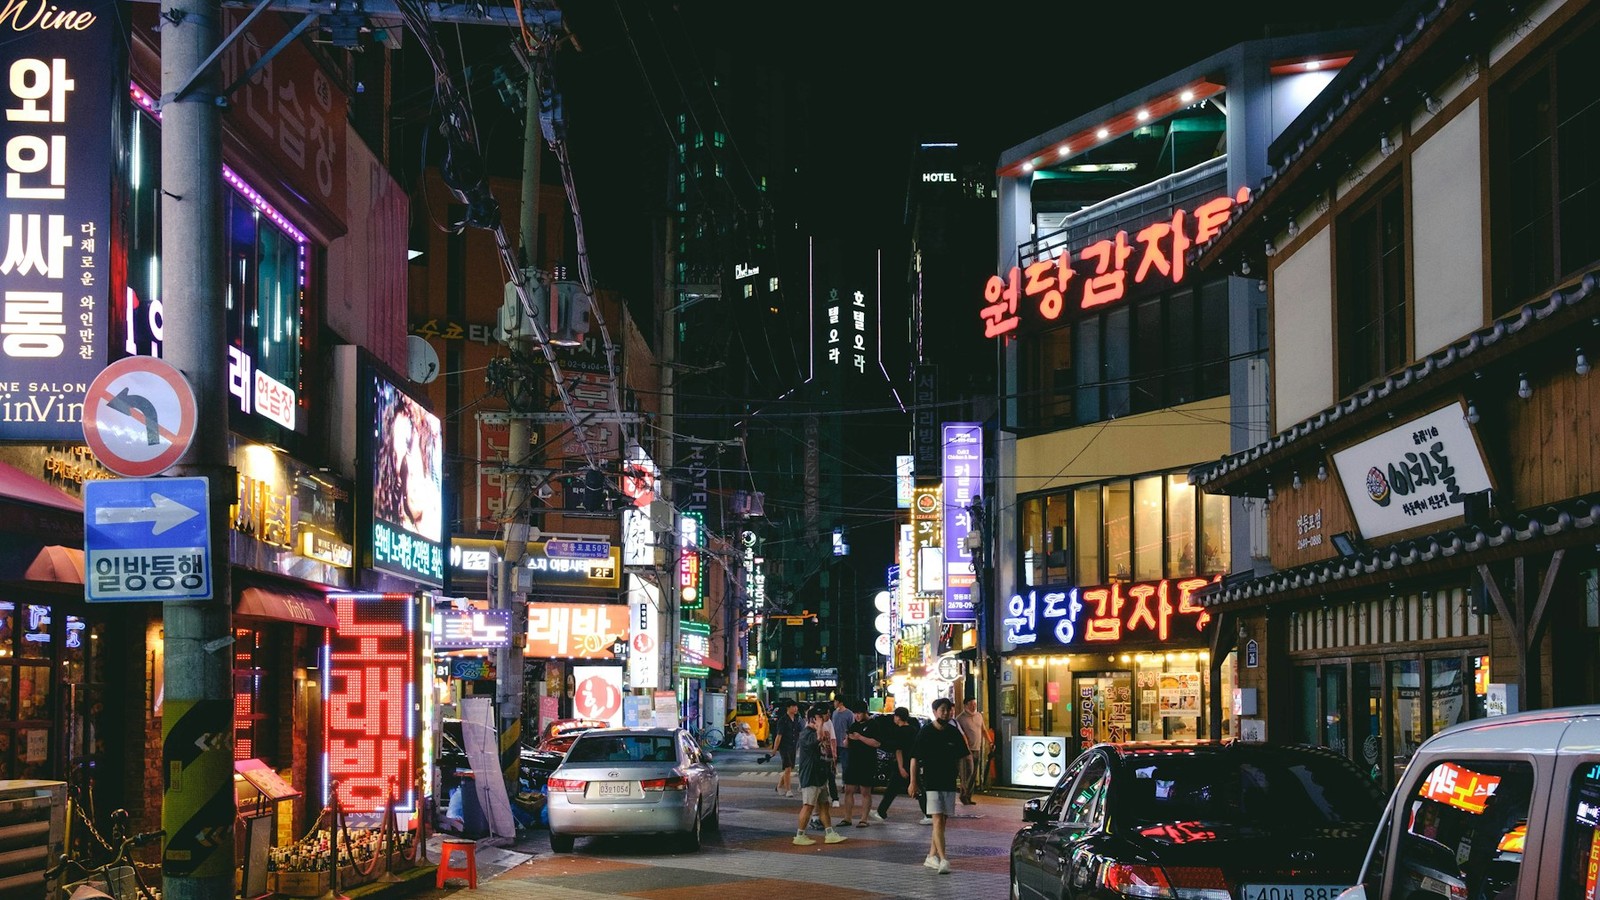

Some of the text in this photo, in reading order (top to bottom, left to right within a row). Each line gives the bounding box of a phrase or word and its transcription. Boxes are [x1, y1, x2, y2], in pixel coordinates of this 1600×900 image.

[0, 0, 96, 32] Wine
[922, 173, 957, 182] HOTEL
[1, 58, 75, 358] 와인싸롱
[80, 222, 96, 286] 다채로운
[29, 383, 86, 392] SALON
[257, 374, 293, 424] 연습장
[0, 393, 83, 422] inVin
[1387, 441, 1465, 504] 이차돌
[1428, 492, 1450, 511] 전문점
[1296, 508, 1322, 534] 영등포점
[96, 554, 203, 592] 일방통행
[596, 569, 610, 578] 2F
[282, 599, 316, 621] VinVin
[614, 643, 627, 653] B1
[331, 596, 408, 811] 노래방
